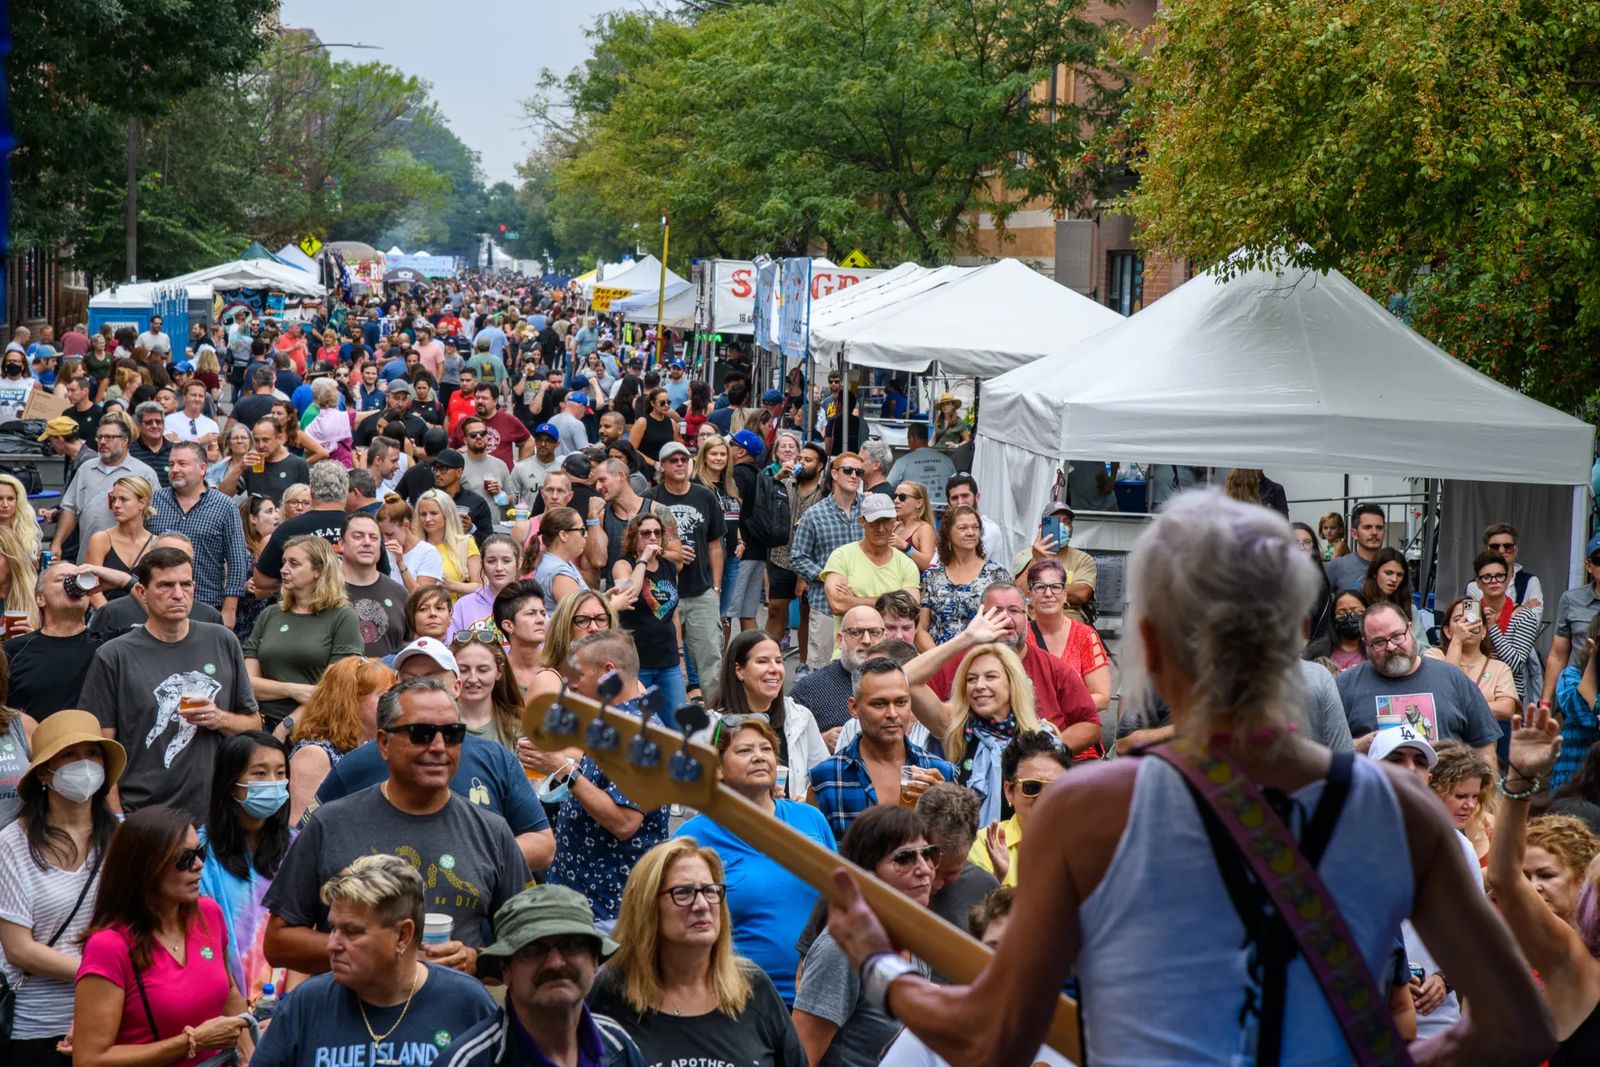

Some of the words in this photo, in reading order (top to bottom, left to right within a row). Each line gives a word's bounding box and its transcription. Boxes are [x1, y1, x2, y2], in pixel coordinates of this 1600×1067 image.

[309, 527, 342, 538] EAT
[314, 1043, 367, 1067] BLUE
[369, 1041, 440, 1067] ISLAND
